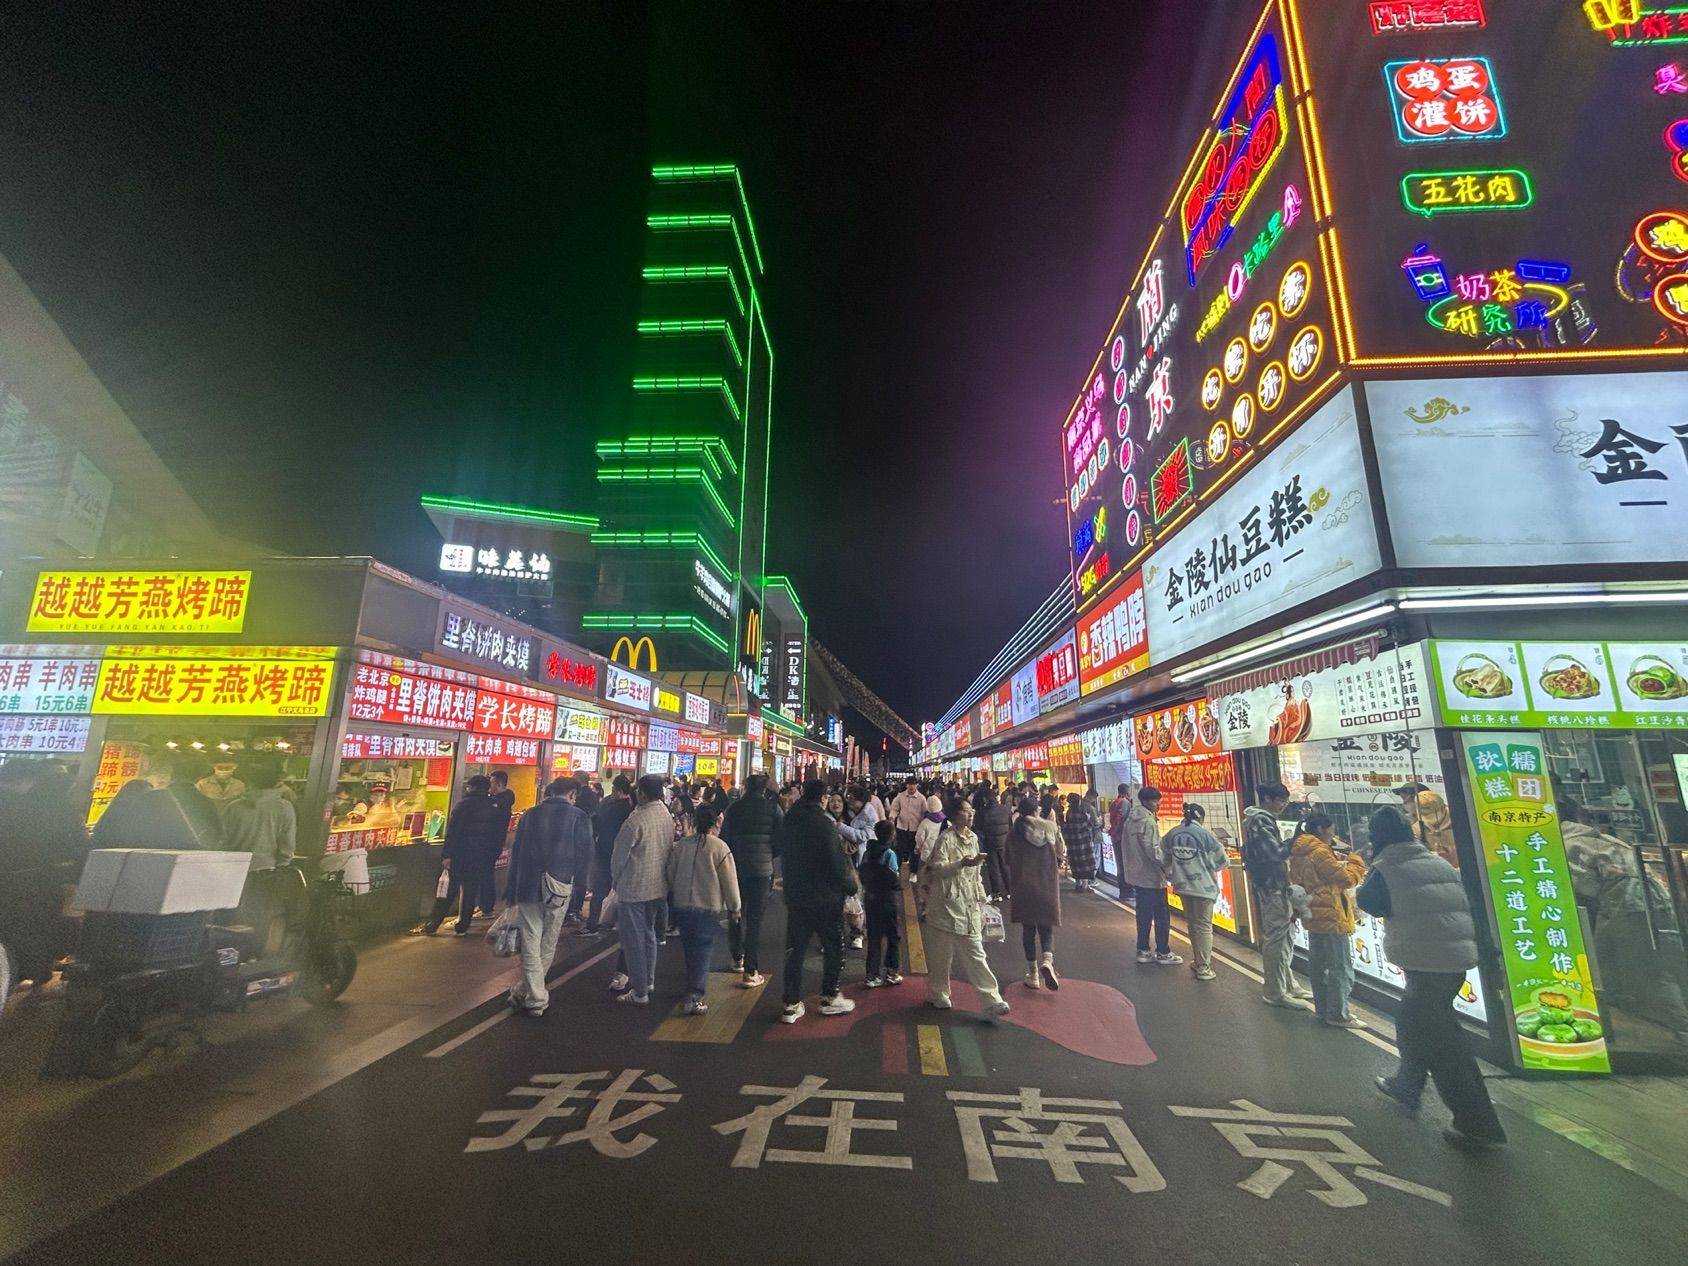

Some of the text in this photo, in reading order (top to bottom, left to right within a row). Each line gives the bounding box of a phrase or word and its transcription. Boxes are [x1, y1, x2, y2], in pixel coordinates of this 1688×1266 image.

[1406, 64, 1481, 92] 鸡蛋
[1410, 100, 1491, 127] 灌饼
[1420, 175, 1517, 206] 五花肉
[1455, 268, 1524, 303] 奶茶
[1152, 302, 1178, 353] JING
[1445, 299, 1551, 336] 研究所
[1579, 419, 1688, 486] 金
[1164, 474, 1314, 612] 金陵仙豆糕
[34, 575, 246, 621] 越越芳燕烤蹄
[1189, 566, 1273, 619] xian dou gao
[1089, 588, 1147, 669] 香辣鸭脖
[38, 660, 98, 691] 羊肉串
[100, 663, 328, 706] 越越芳燕烤蹄
[356, 666, 390, 687] 老北京
[35, 694, 88, 712] 15元6串
[351, 703, 384, 720] 12元3个
[353, 685, 388, 705] 炸鸡腿
[396, 677, 477, 722] 里脊饼肉夹馍
[477, 695, 553, 736] 学长烤蹄
[1227, 708, 1251, 731] 金陵
[1635, 714, 1688, 725] 红豆沙青
[1475, 750, 1537, 773] 软糯
[1484, 777, 1543, 799] 糕团
[1488, 810, 1547, 824] 南京特产
[1496, 843, 1537, 962] 十二道工艺
[1526, 832, 1575, 975] 手工精心制作
[464, 1069, 1454, 1208] 我在南京
